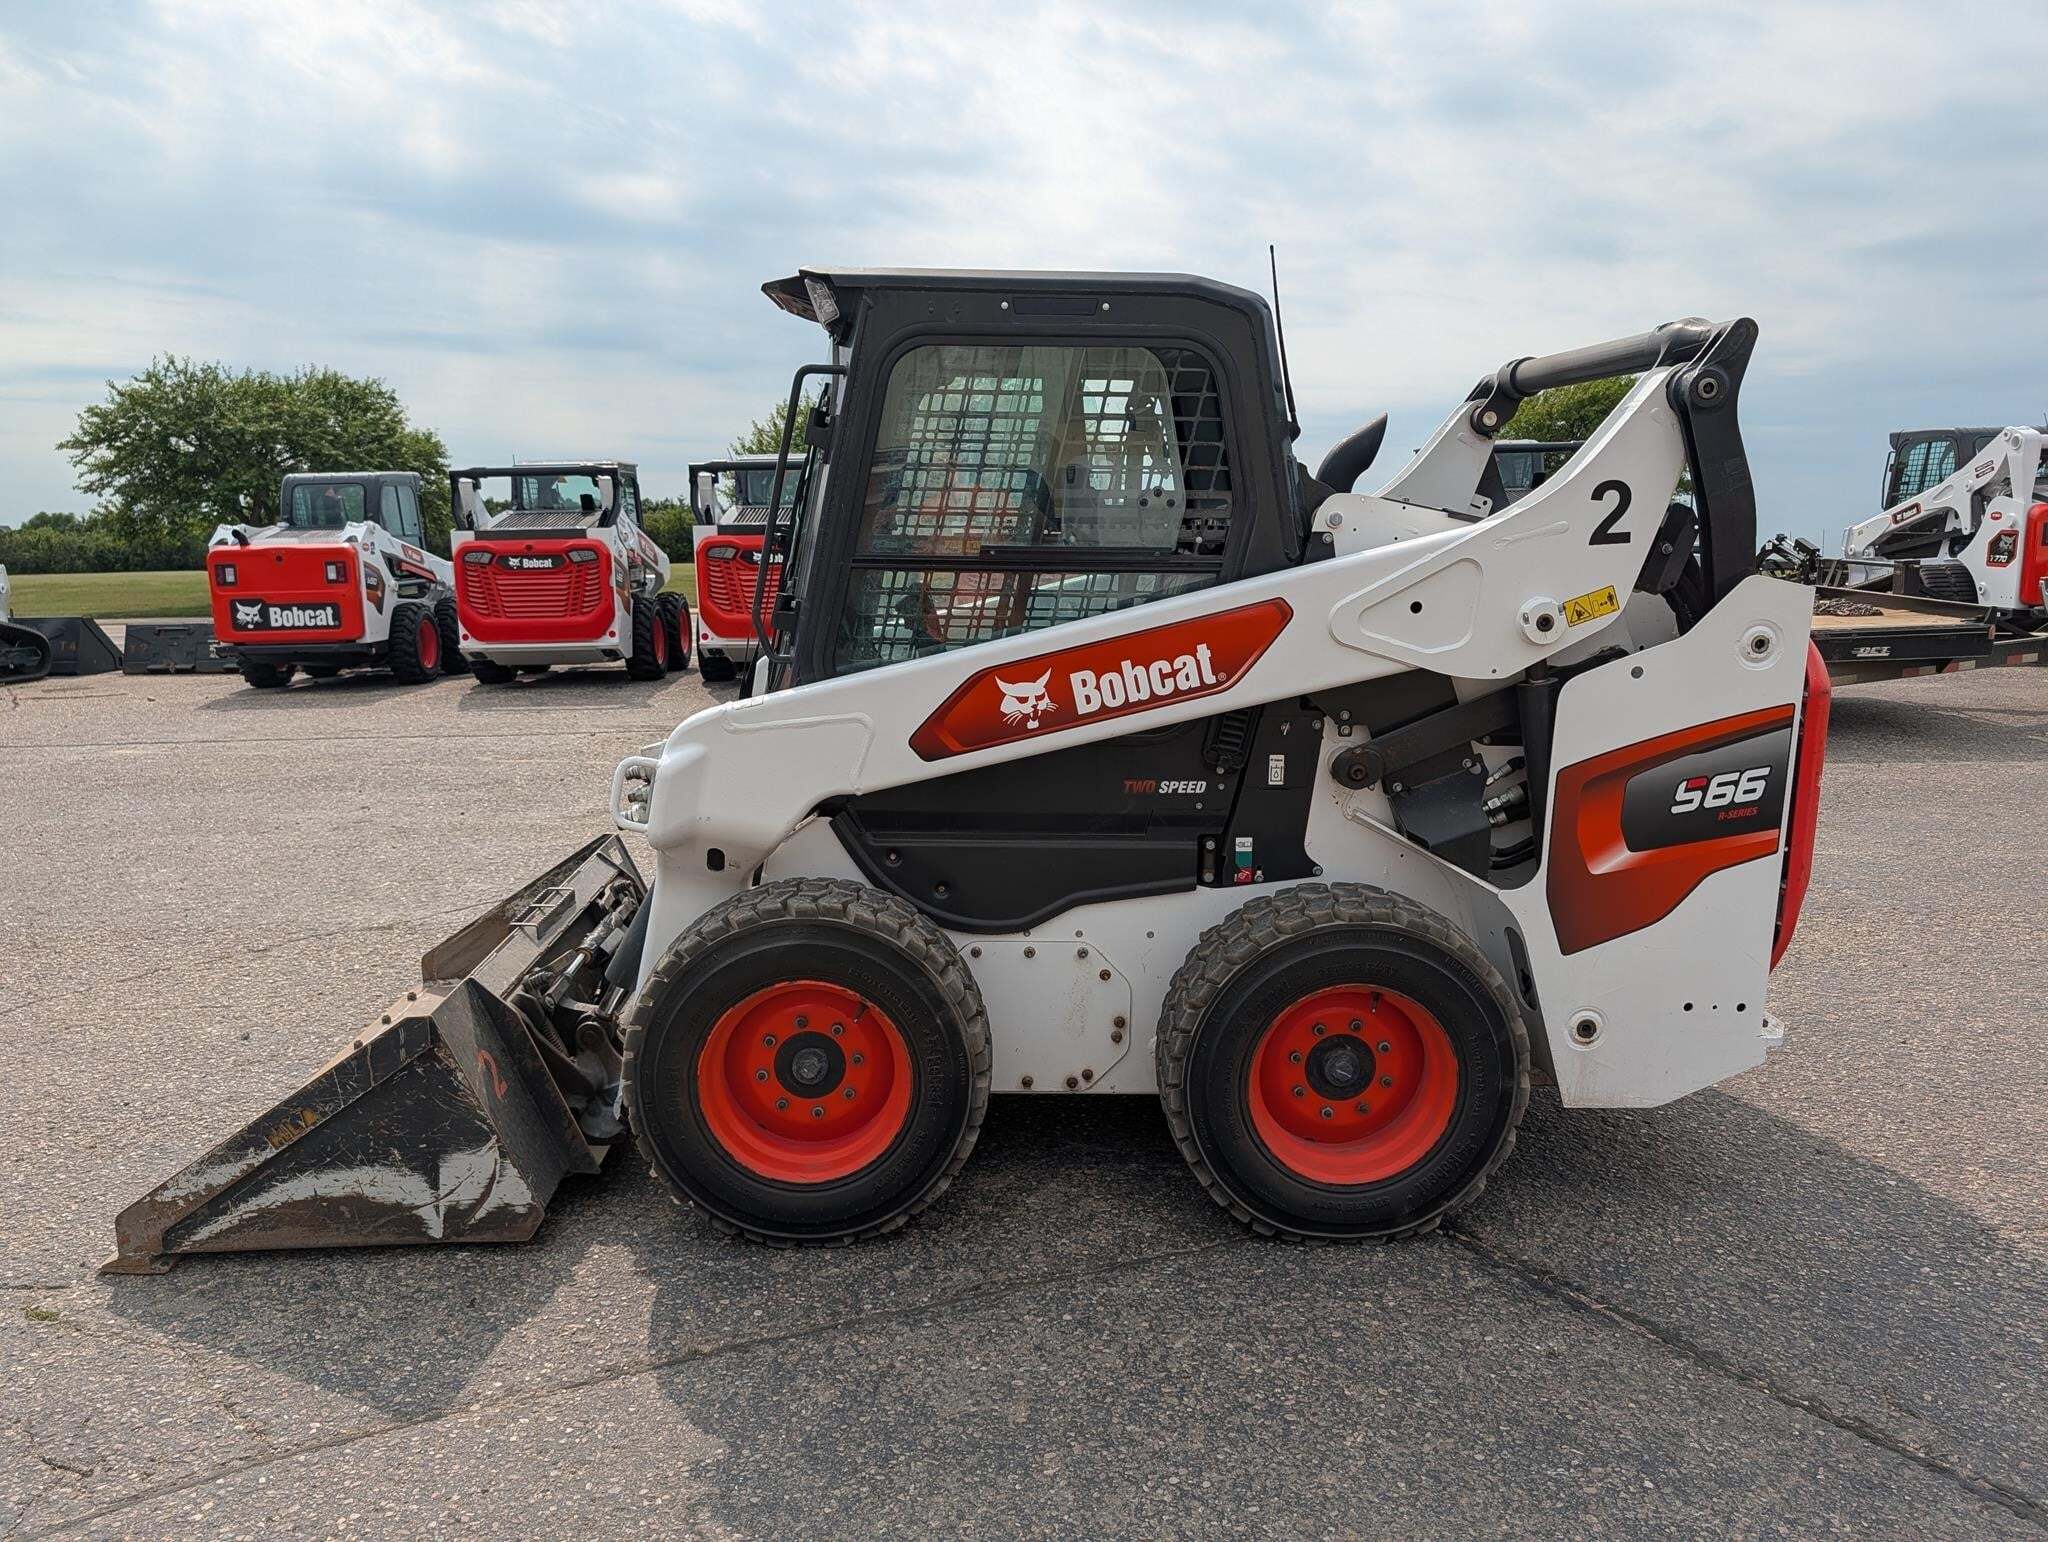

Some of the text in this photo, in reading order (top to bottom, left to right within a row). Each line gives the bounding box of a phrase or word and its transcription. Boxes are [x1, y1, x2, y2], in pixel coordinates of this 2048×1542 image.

[1589, 480, 1632, 546] 2
[522, 558, 552, 568] Bobcat
[269, 606, 334, 627] Bobcat
[1069, 643, 1216, 715] Bobcat
[1123, 780, 1207, 793] TWO SPEED
[1671, 766, 1771, 814] S66
[1718, 806, 1759, 821] R-SERIES
